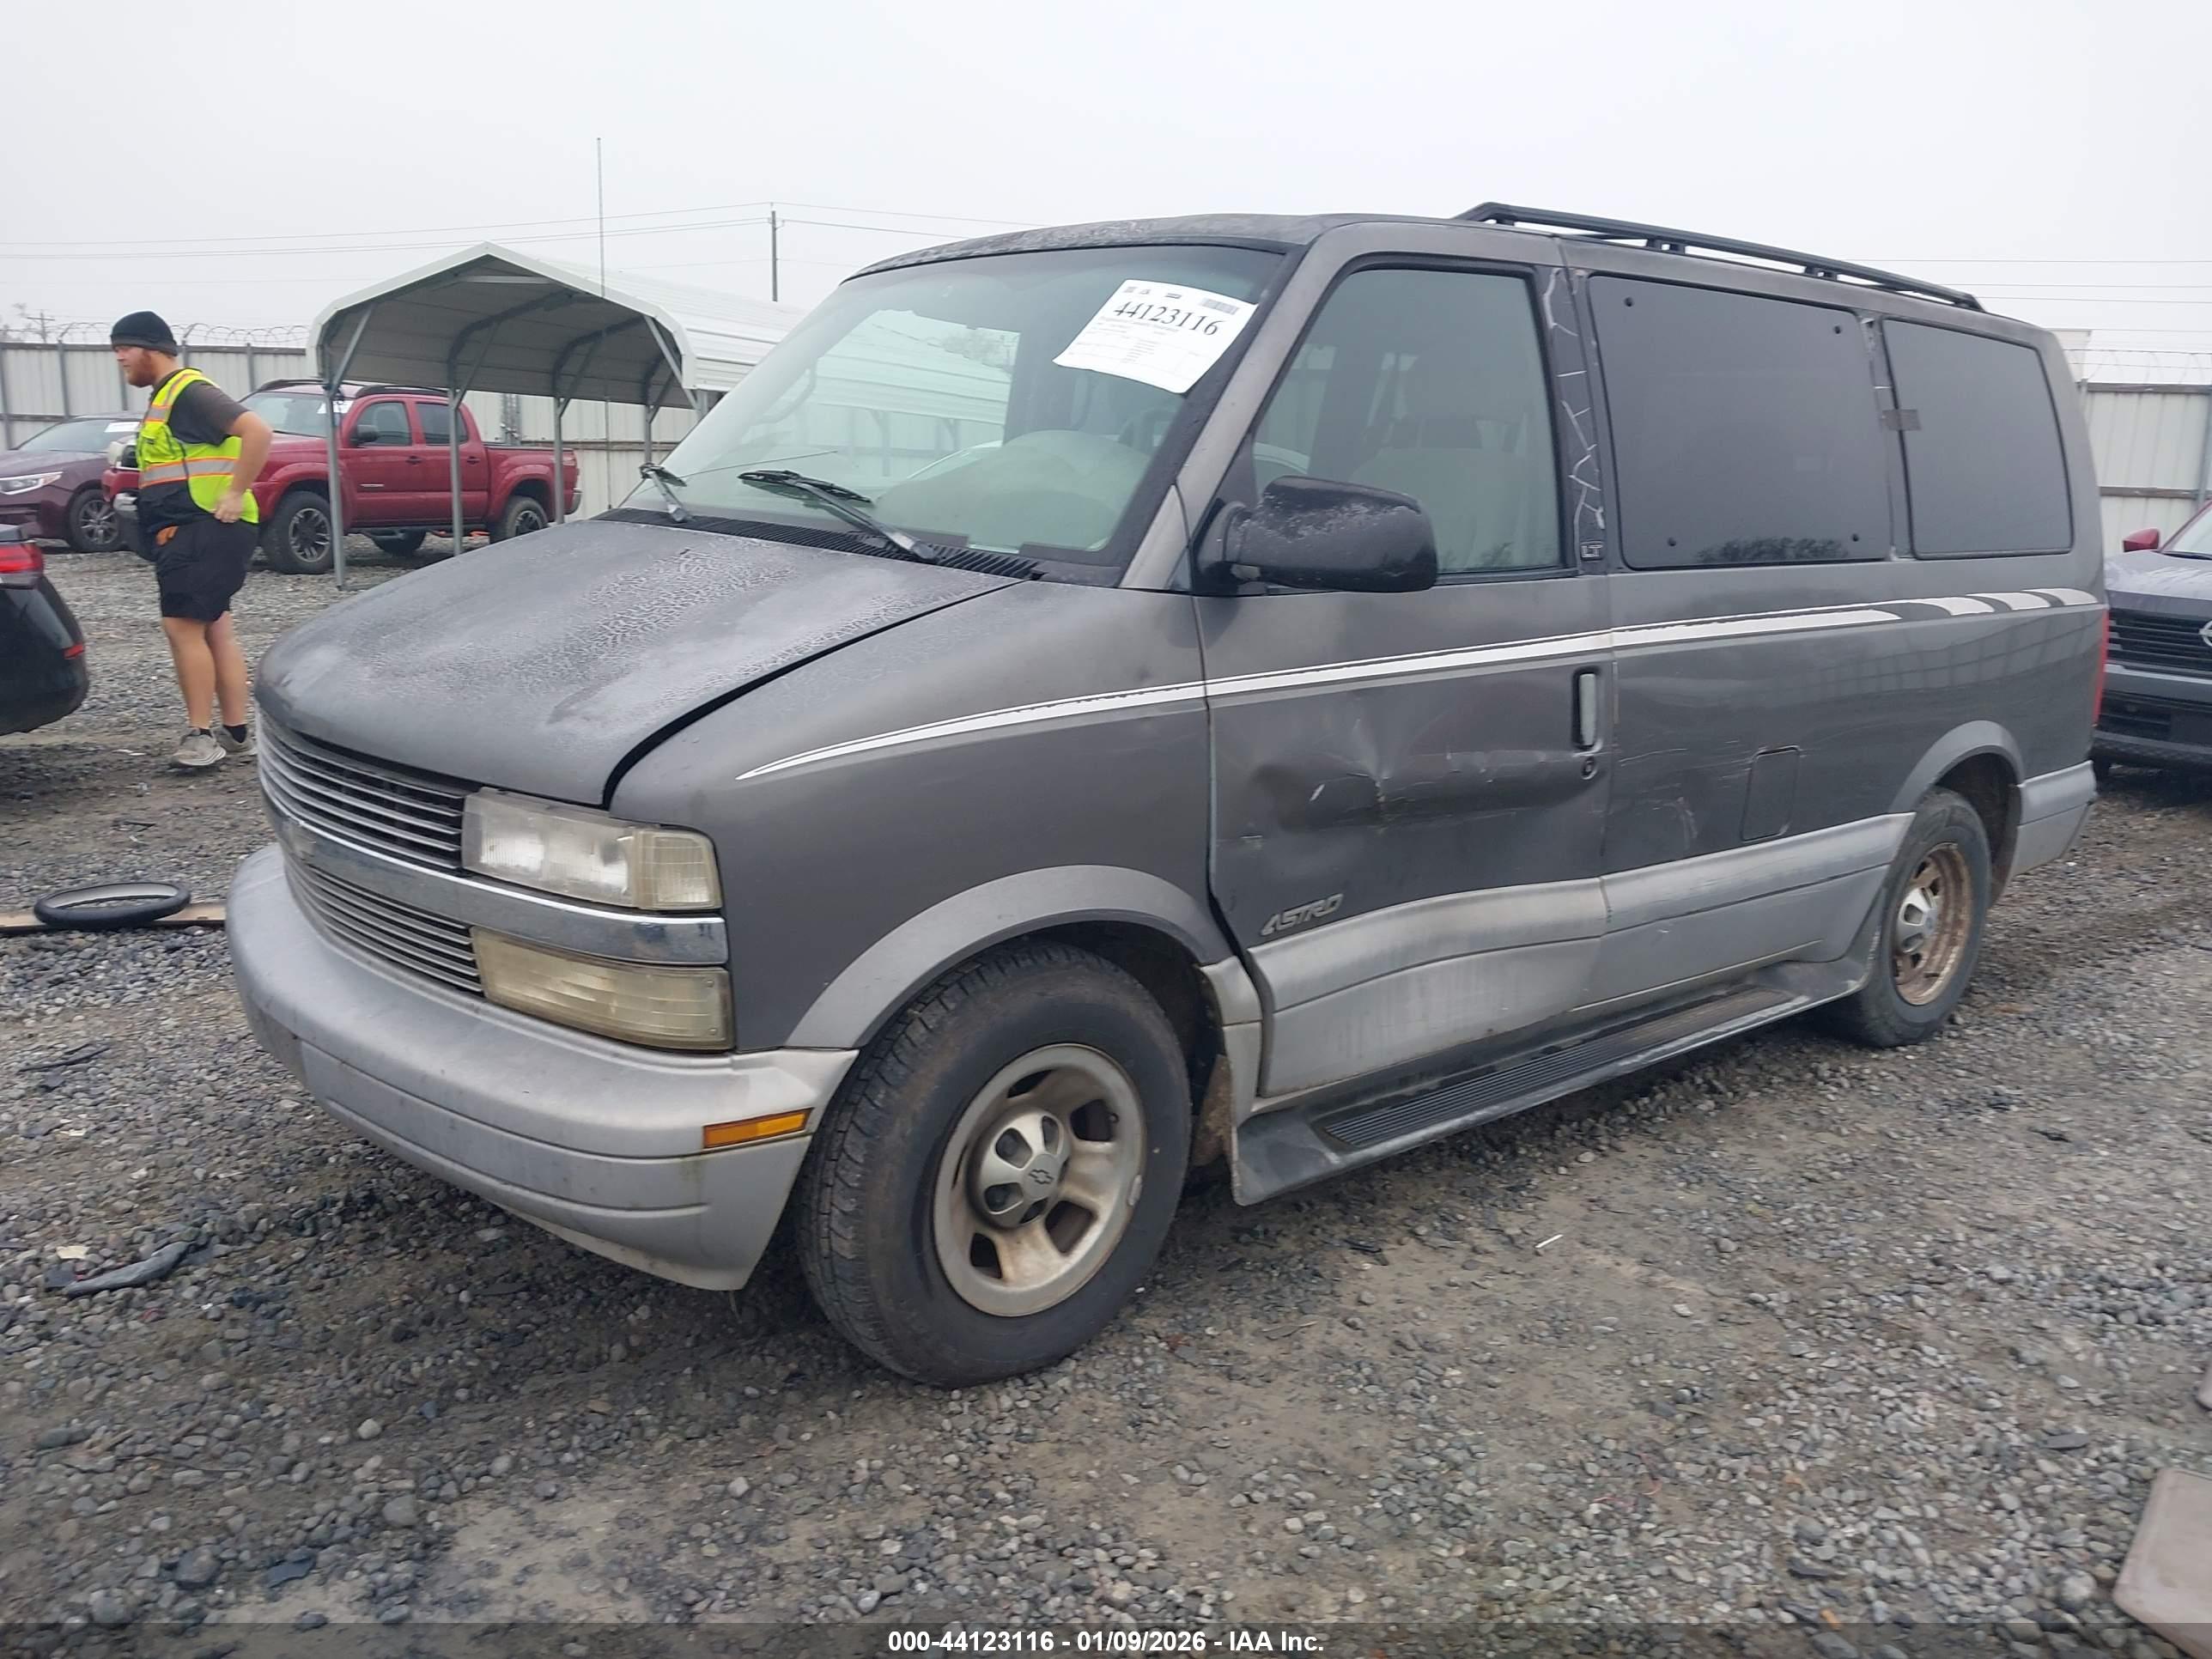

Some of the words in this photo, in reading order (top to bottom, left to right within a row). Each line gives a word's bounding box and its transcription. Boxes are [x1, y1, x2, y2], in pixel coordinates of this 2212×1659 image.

[1114, 301, 1225, 336] 44123116
[1581, 544, 1603, 558] LT
[1260, 892, 1344, 936] ASTRO
